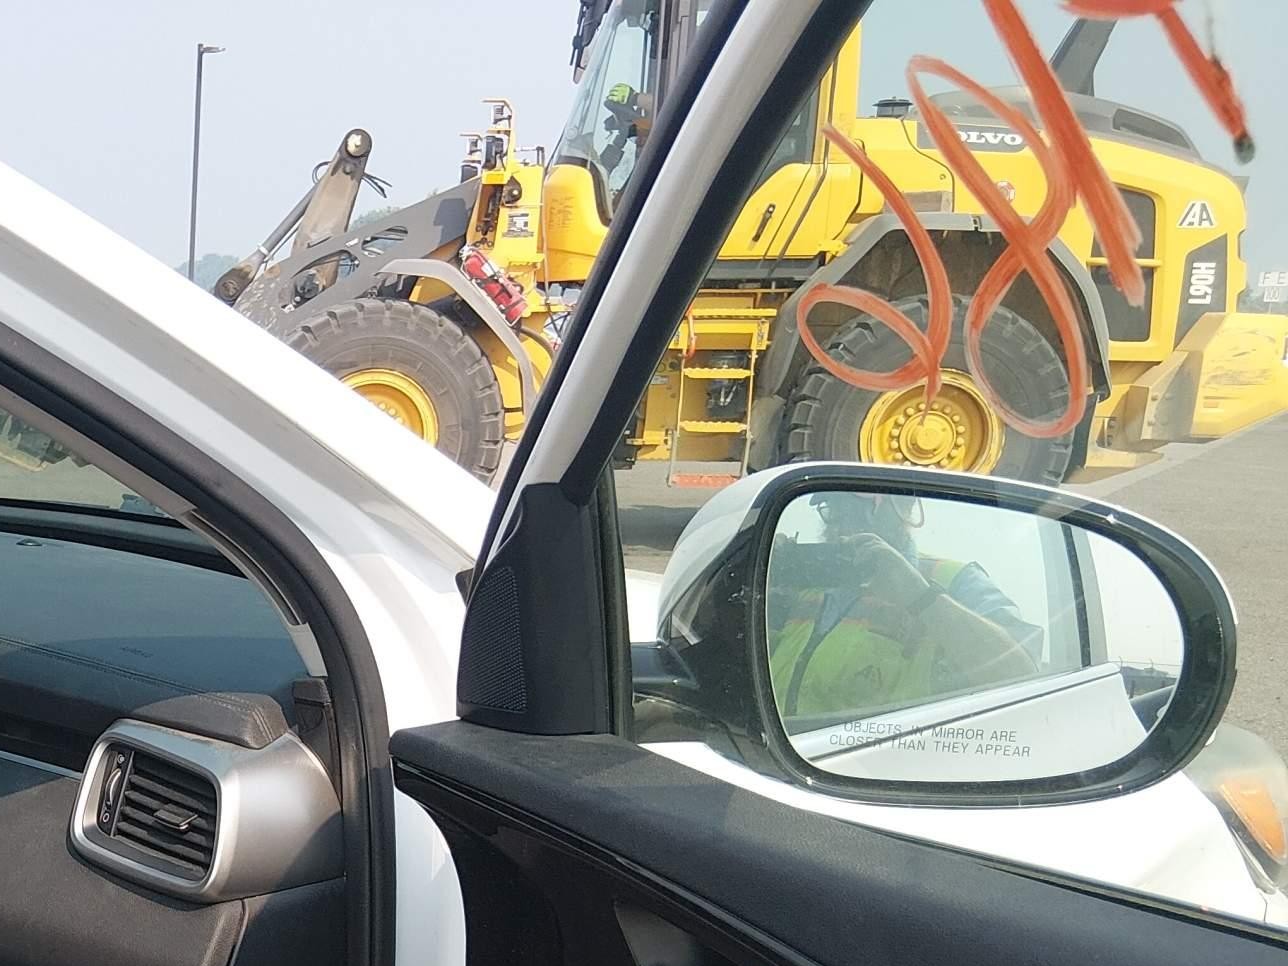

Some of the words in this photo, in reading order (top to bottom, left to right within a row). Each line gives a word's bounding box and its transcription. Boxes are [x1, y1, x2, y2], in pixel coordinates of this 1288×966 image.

[1187, 262, 1217, 305] L90H
[843, 721, 902, 735] OBJECTS
[911, 724, 925, 737] IN
[931, 727, 985, 741] MIRROR
[990, 730, 1017, 743] ARE
[829, 734, 882, 747] CLOSER
[890, 739, 927, 752] THAN
[934, 741, 969, 754] THEY
[974, 744, 1032, 758] APPEAR
